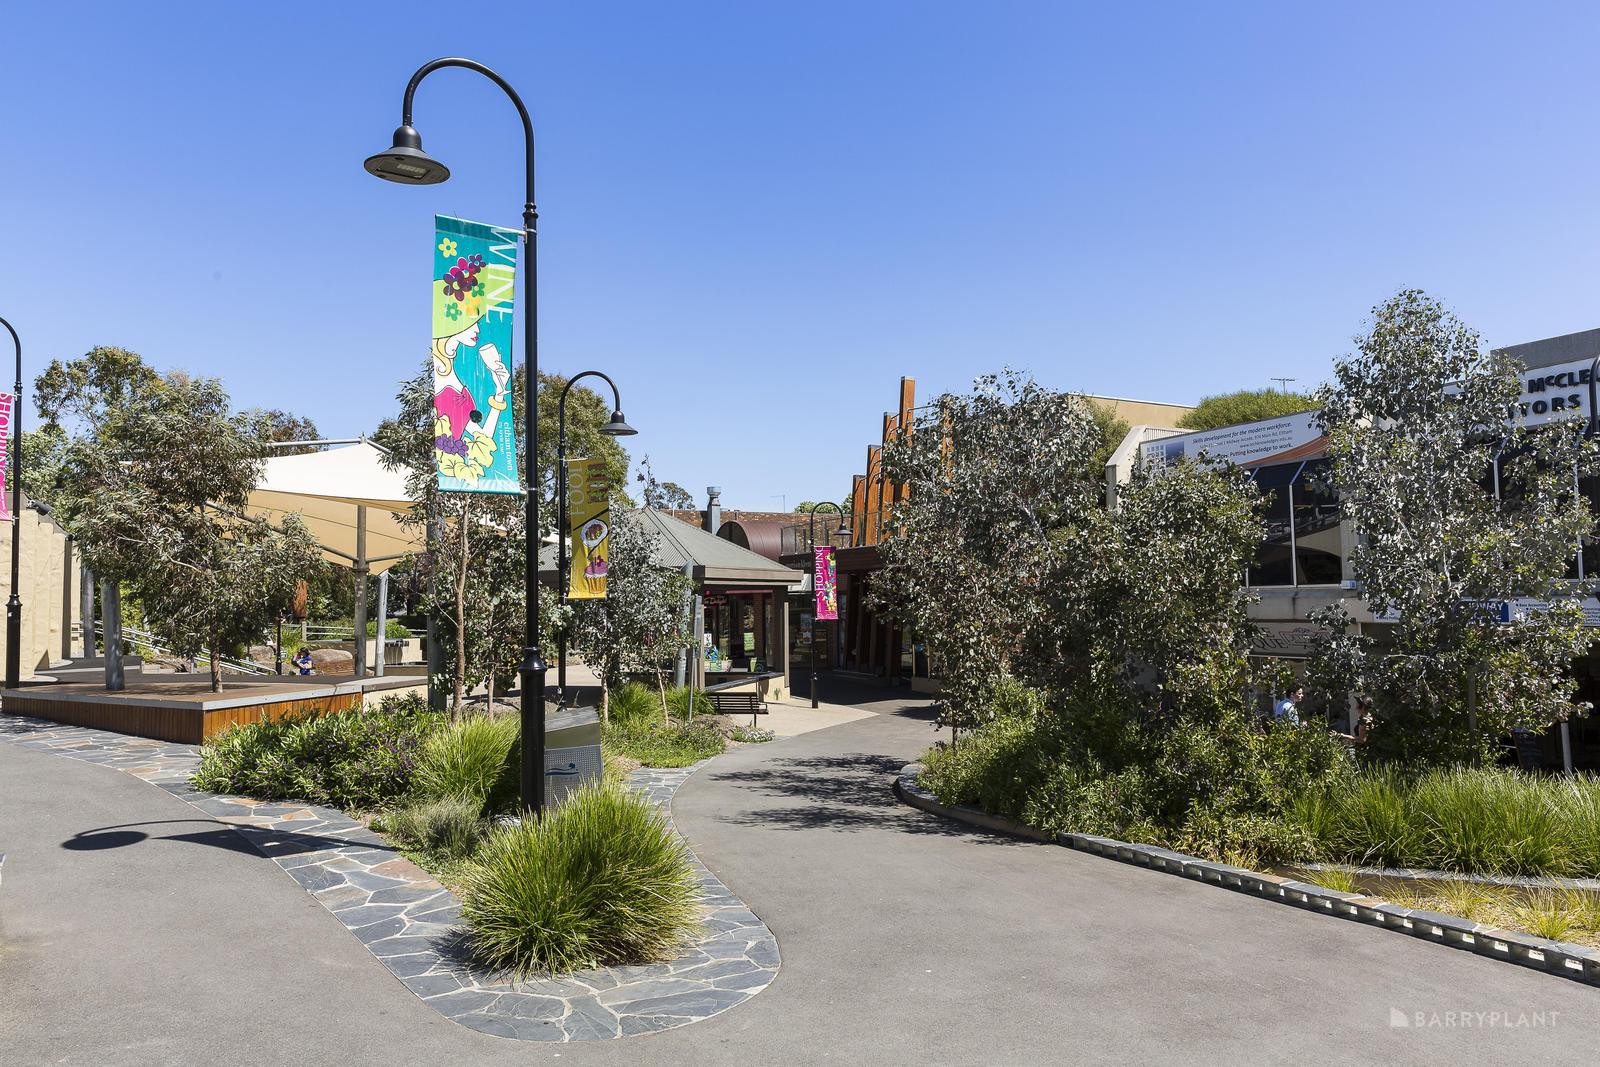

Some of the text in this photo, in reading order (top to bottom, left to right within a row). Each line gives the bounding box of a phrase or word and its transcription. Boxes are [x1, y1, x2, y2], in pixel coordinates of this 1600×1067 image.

[486, 227, 518, 323] WINE
[1528, 369, 1600, 393] McCLE
[503, 422, 513, 471] eltham town
[1229, 449, 1246, 457] Putting
[1246, 445, 1272, 455] knowledge
